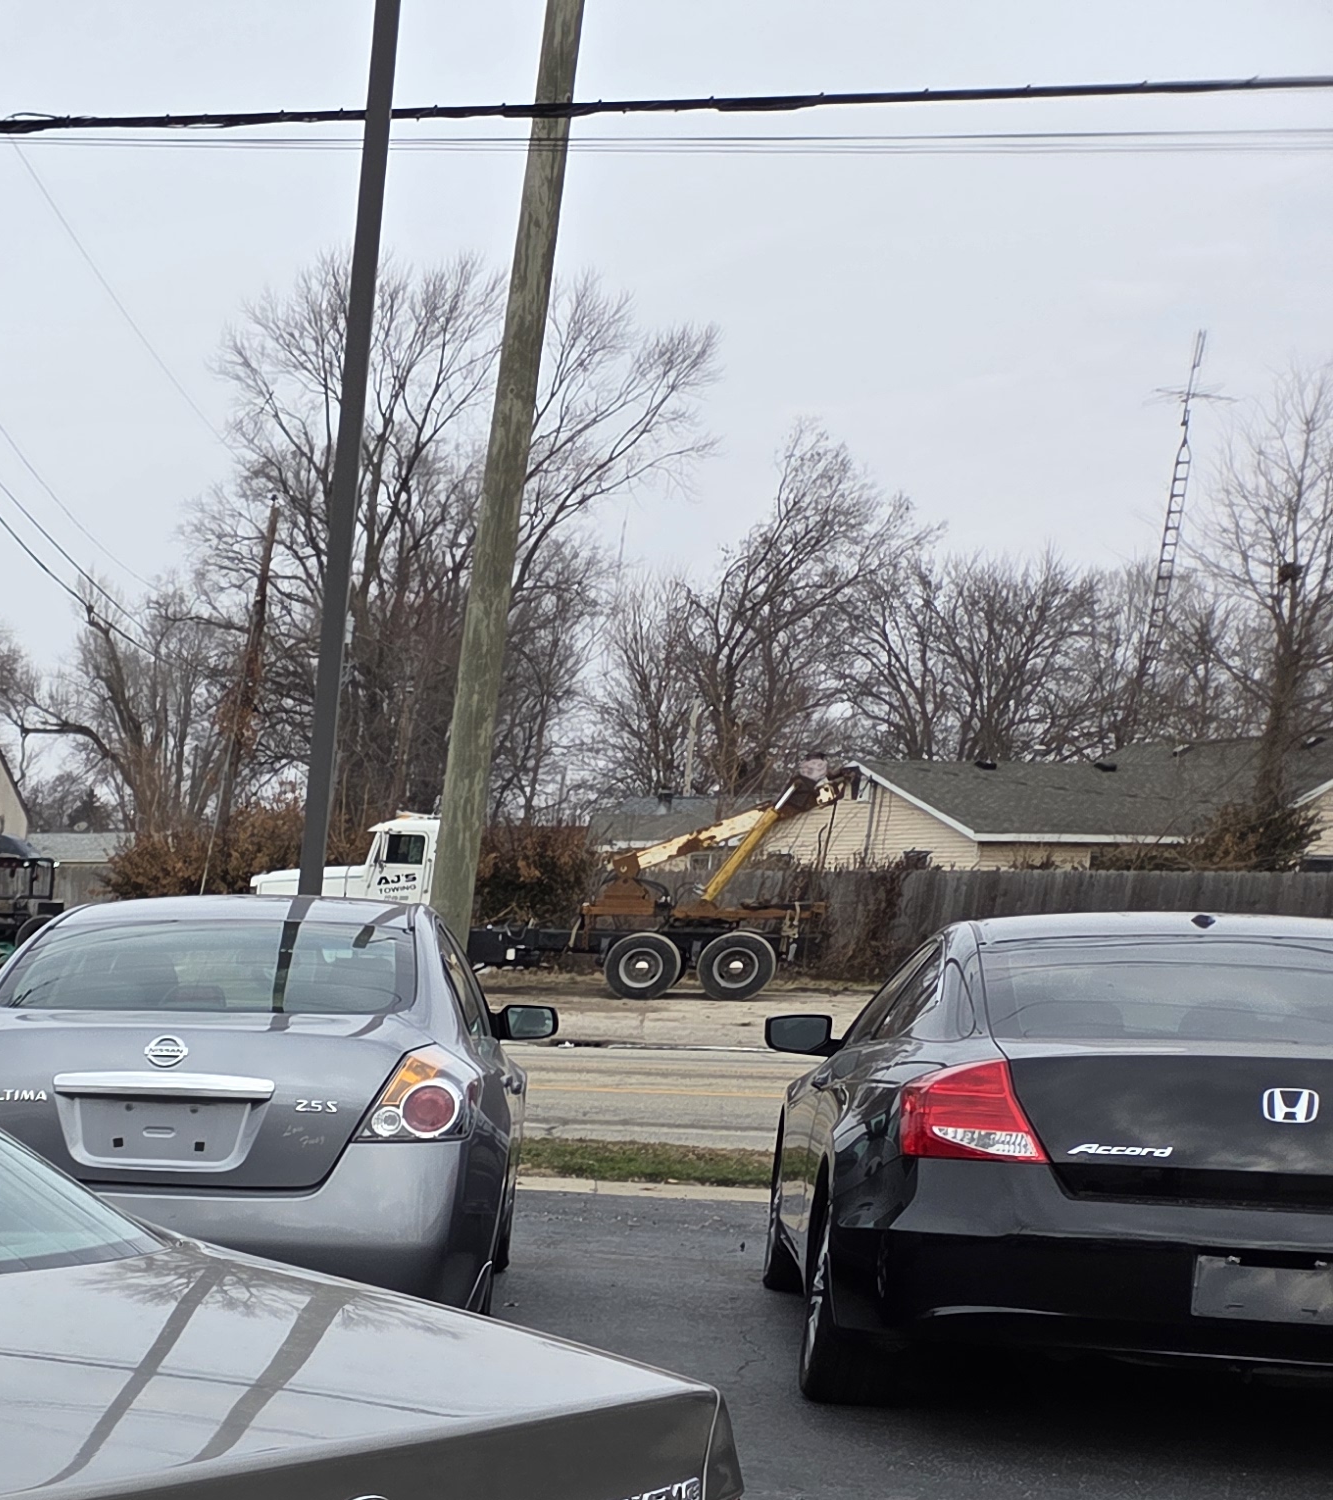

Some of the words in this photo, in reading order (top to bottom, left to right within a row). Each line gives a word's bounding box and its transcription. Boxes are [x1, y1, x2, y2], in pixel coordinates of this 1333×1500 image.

[377, 873, 417, 886] AJ'S
[325, 1100, 338, 1113] S
[1067, 1143, 1173, 1158] Accord
